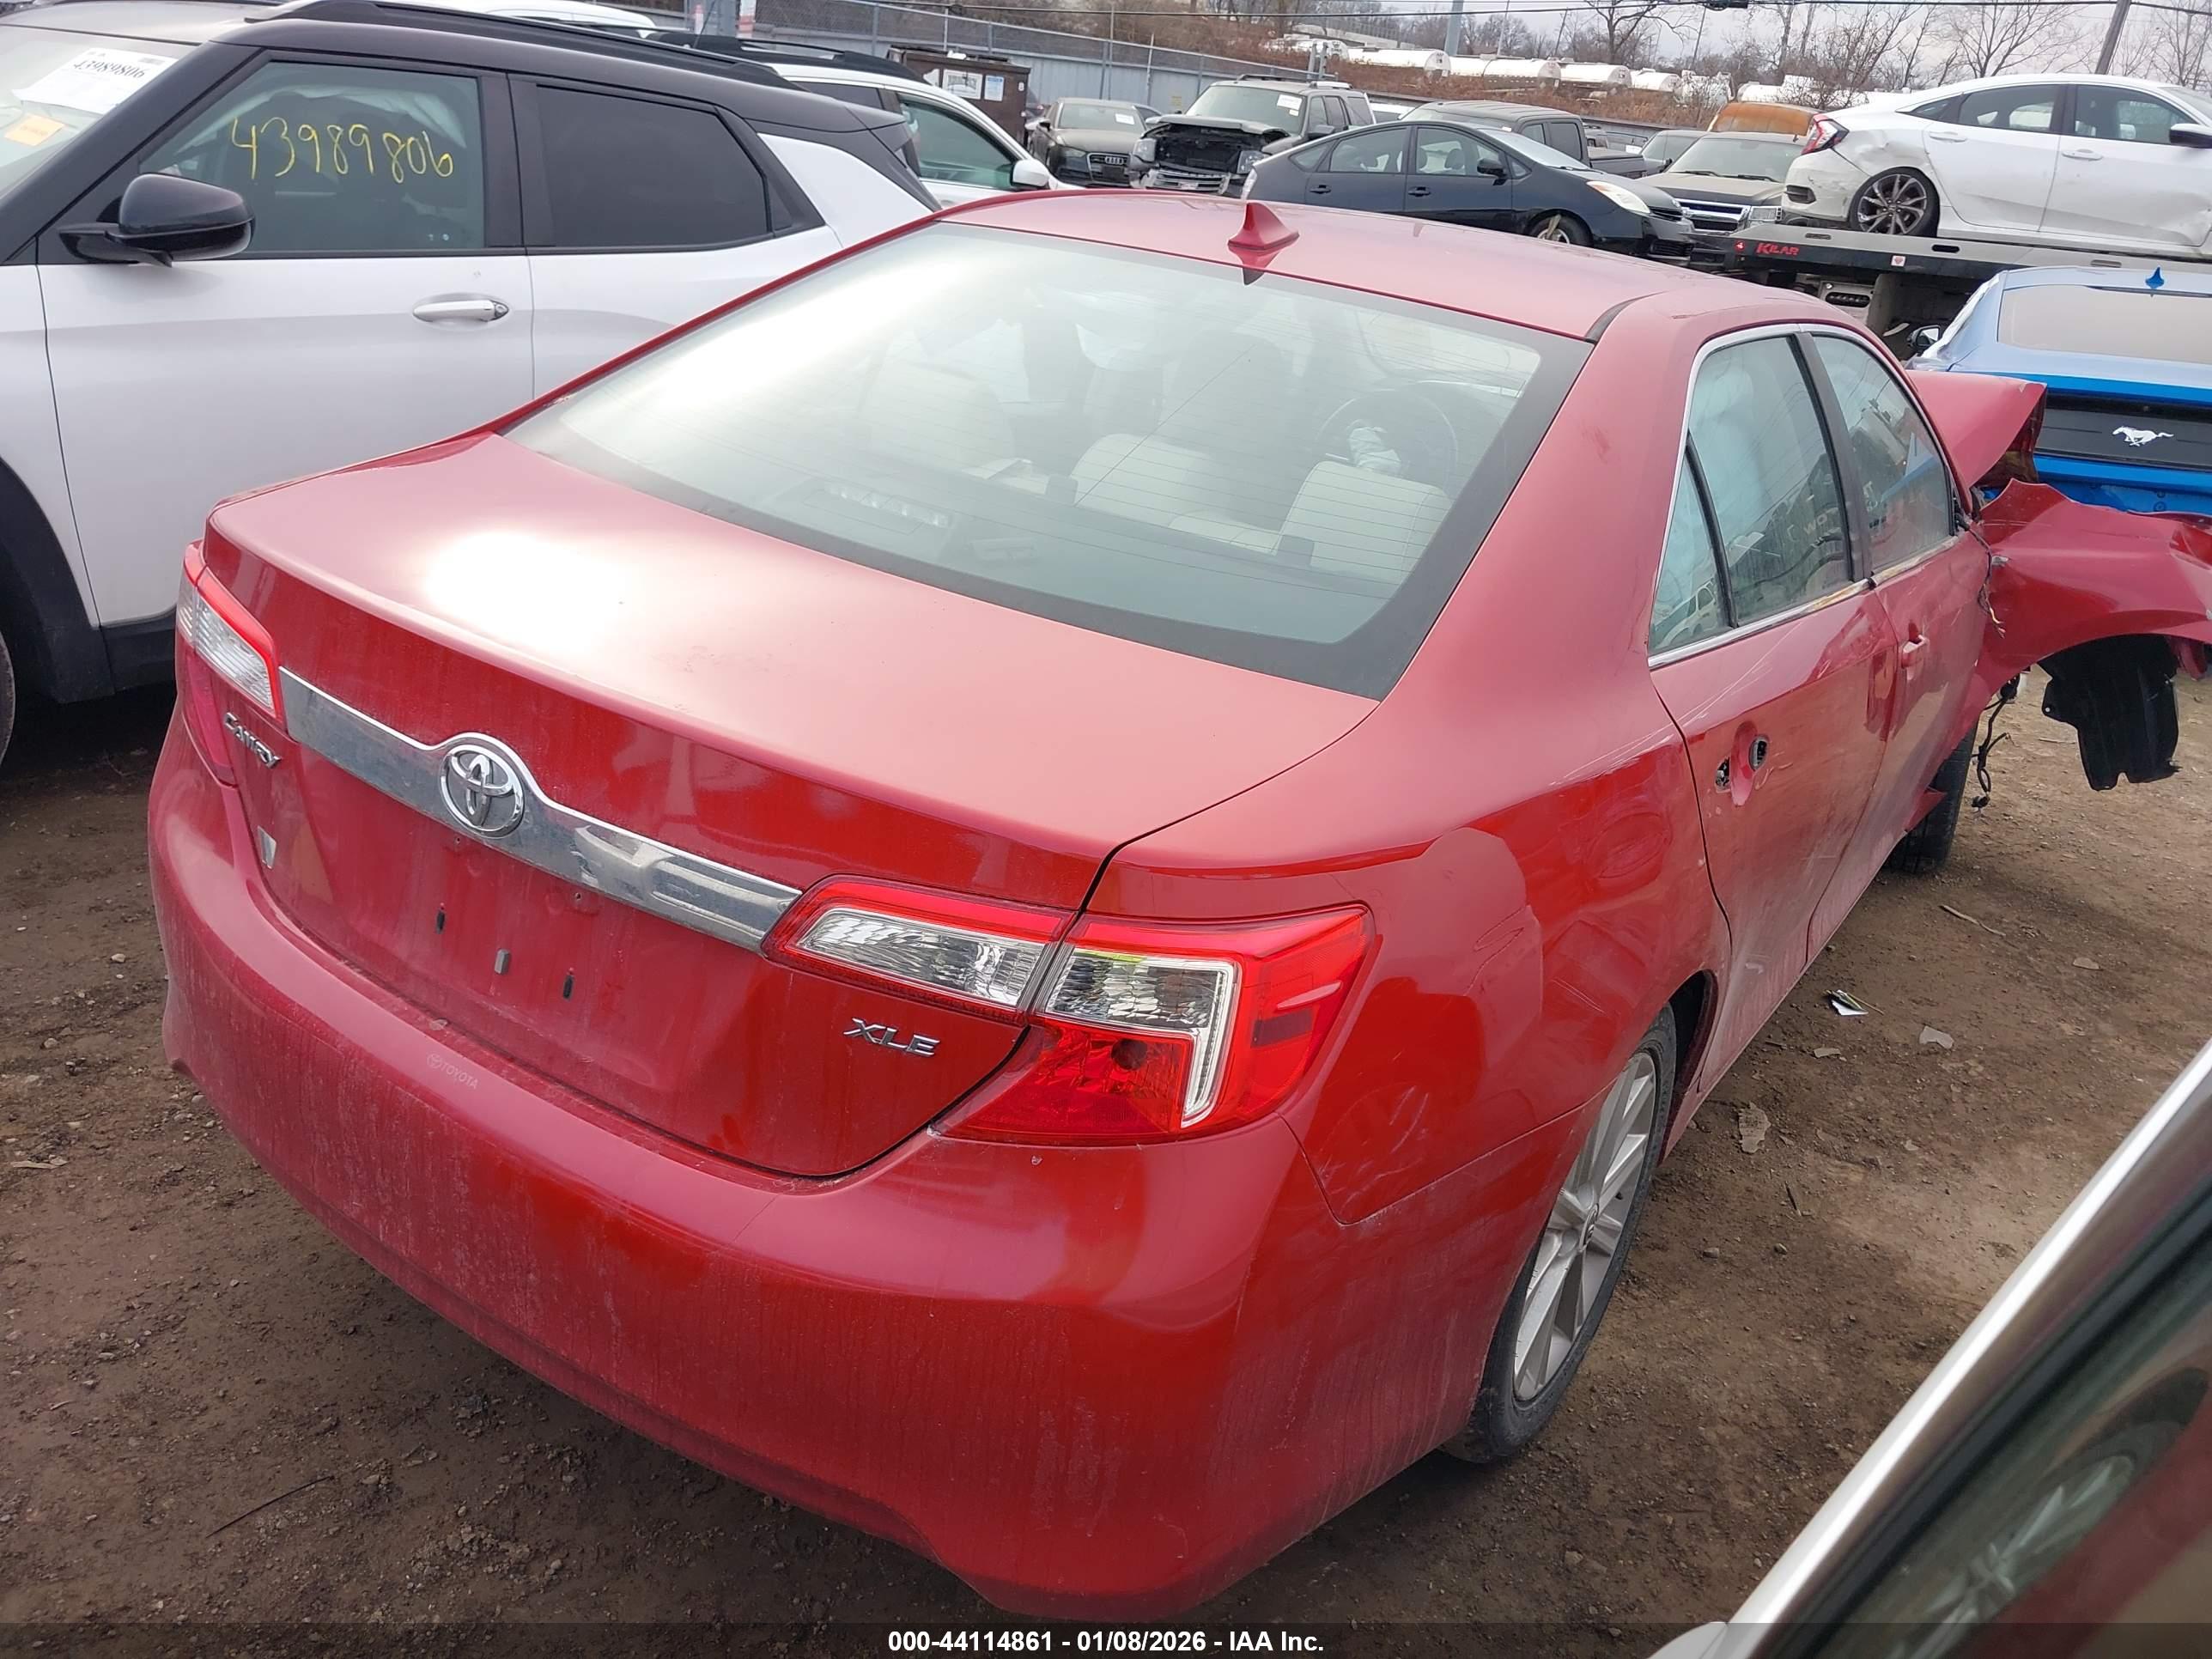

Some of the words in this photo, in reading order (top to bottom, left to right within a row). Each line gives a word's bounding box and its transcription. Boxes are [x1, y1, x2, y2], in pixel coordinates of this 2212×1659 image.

[231, 116, 454, 184] 43989806
[1756, 242, 1800, 256] KILAR
[842, 1017, 941, 1058] XLE
[440, 1061, 480, 1090] TOYOTA
